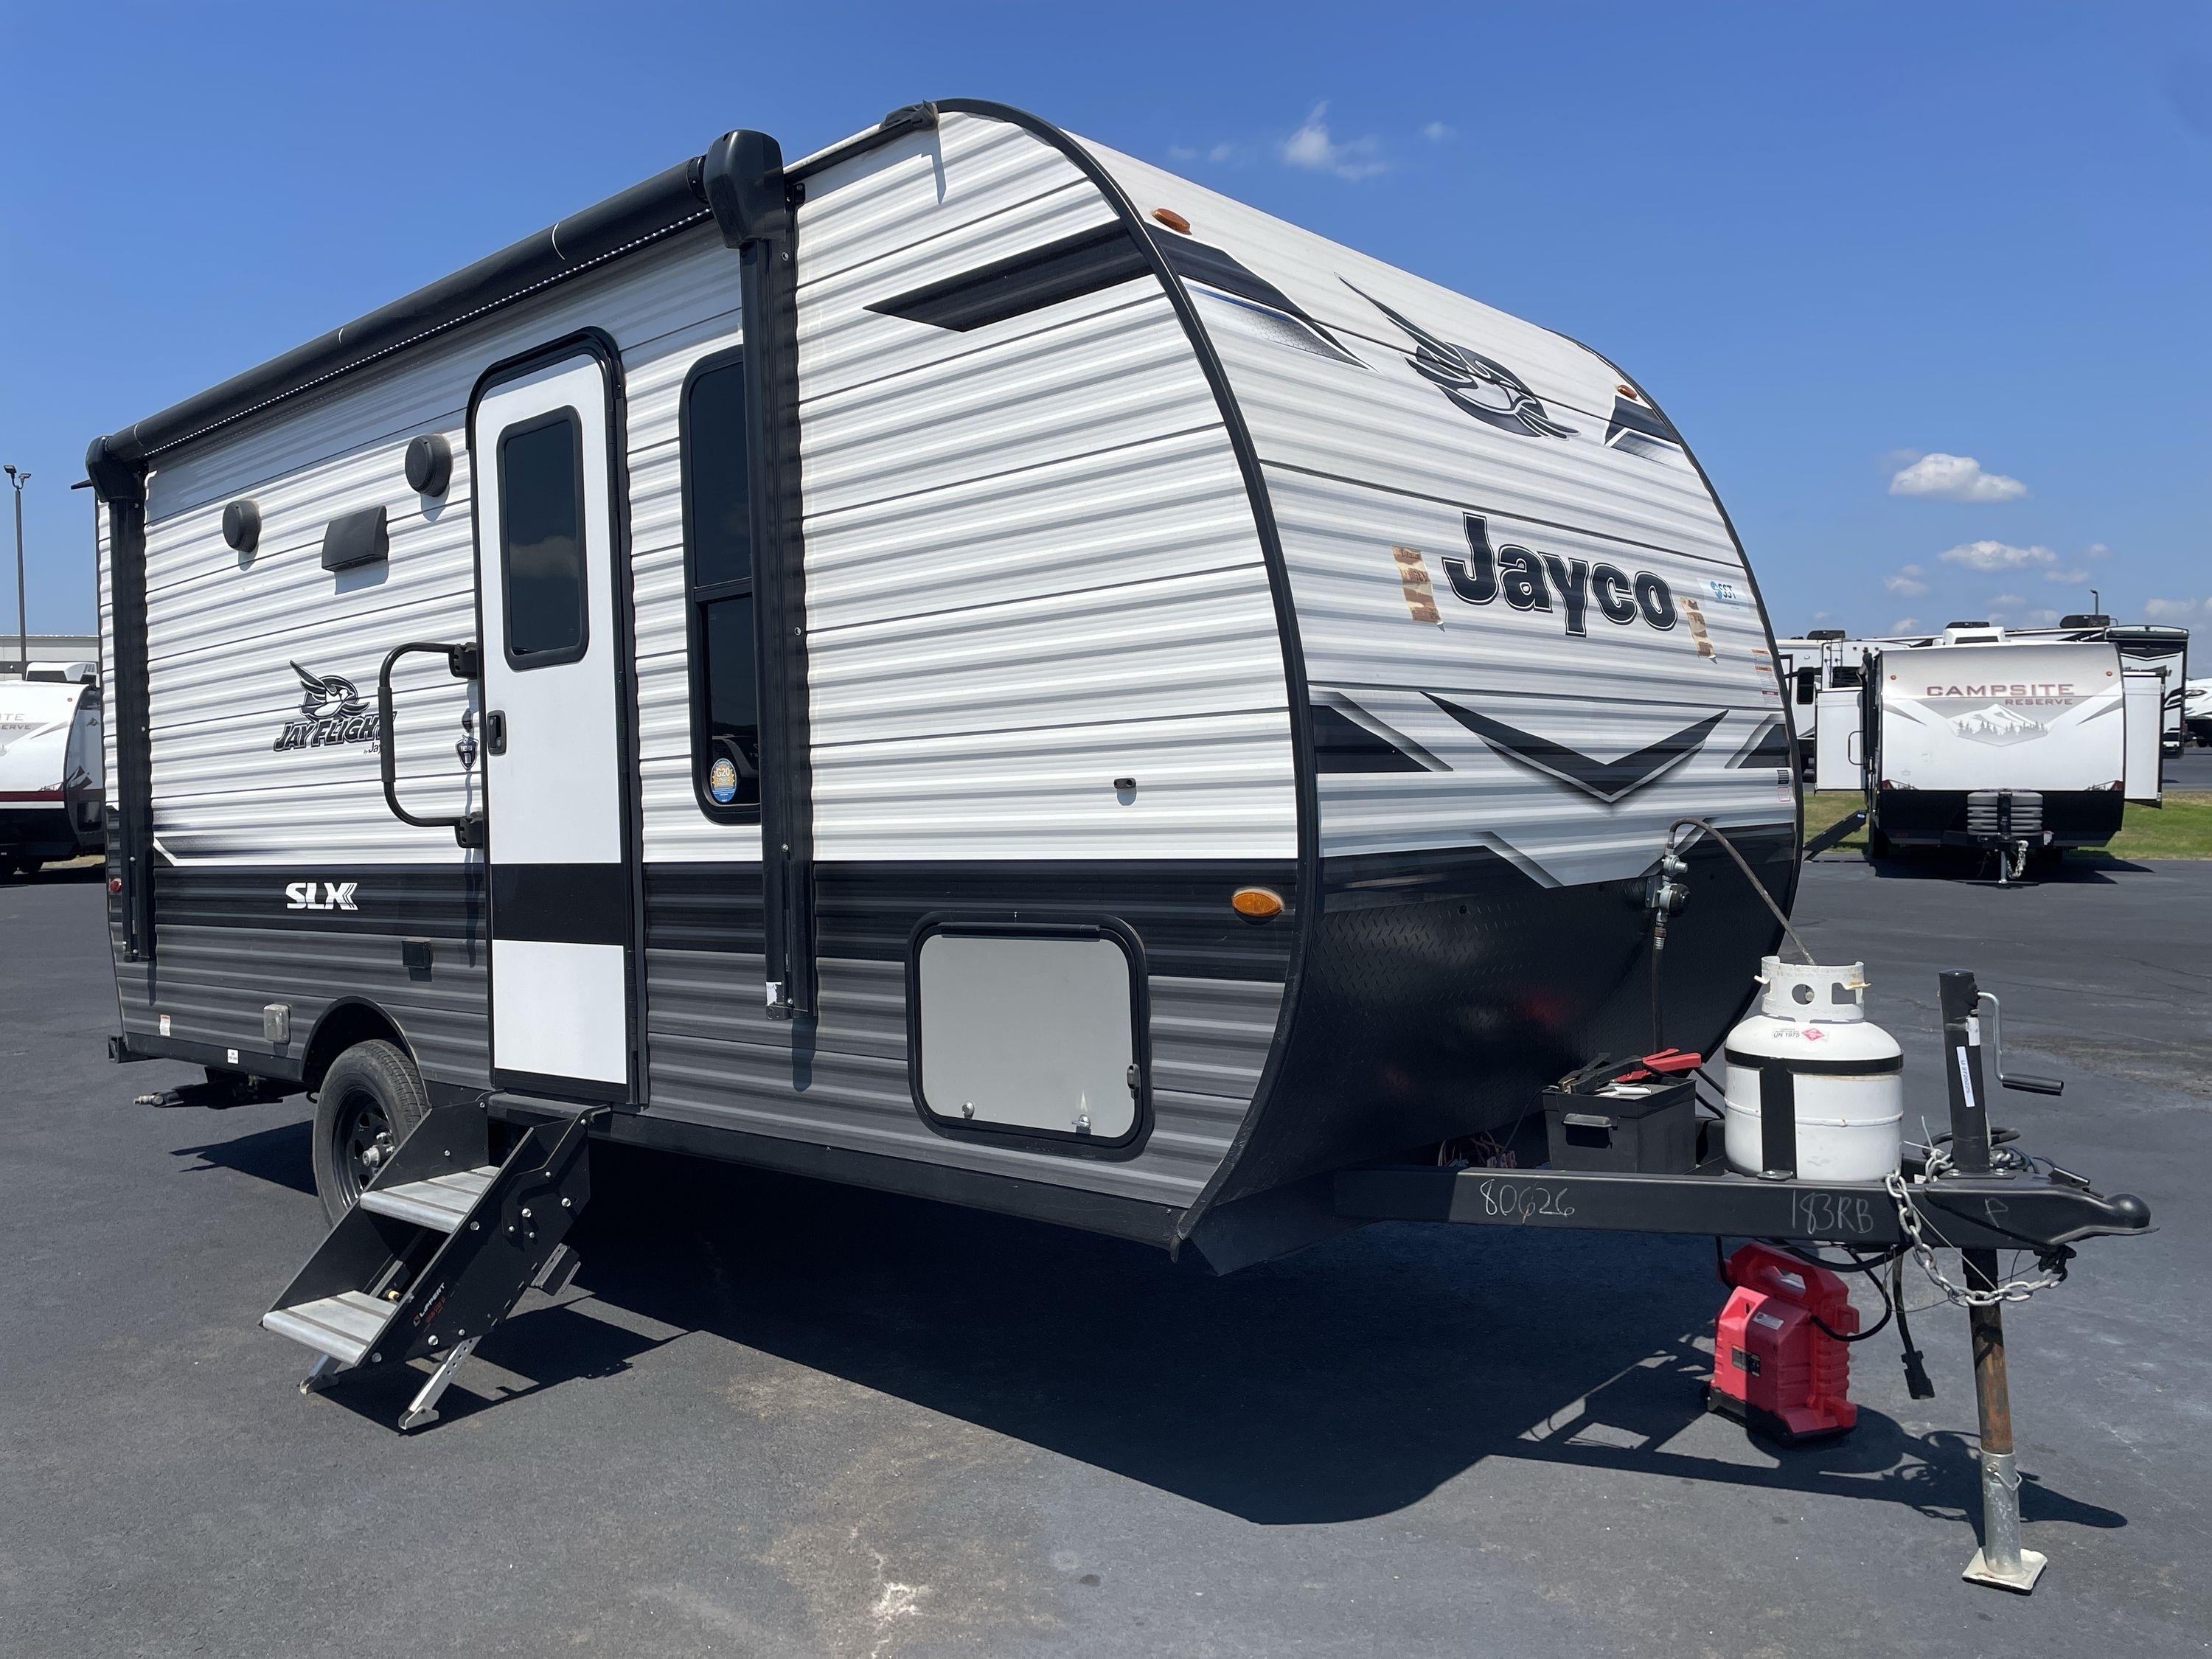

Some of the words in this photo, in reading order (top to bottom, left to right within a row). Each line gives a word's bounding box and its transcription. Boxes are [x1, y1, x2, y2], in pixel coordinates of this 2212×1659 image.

[1441, 511, 1678, 639] Jayco
[1926, 684, 2076, 697] CAMPSITE
[273, 720, 318, 752] JAY
[716, 768, 731, 778] G20
[285, 882, 359, 911] SLX
[1480, 1178, 1576, 1218] 80626
[1792, 1189, 1874, 1235] 183RB
[419, 1281, 445, 1318] LIPPERT
